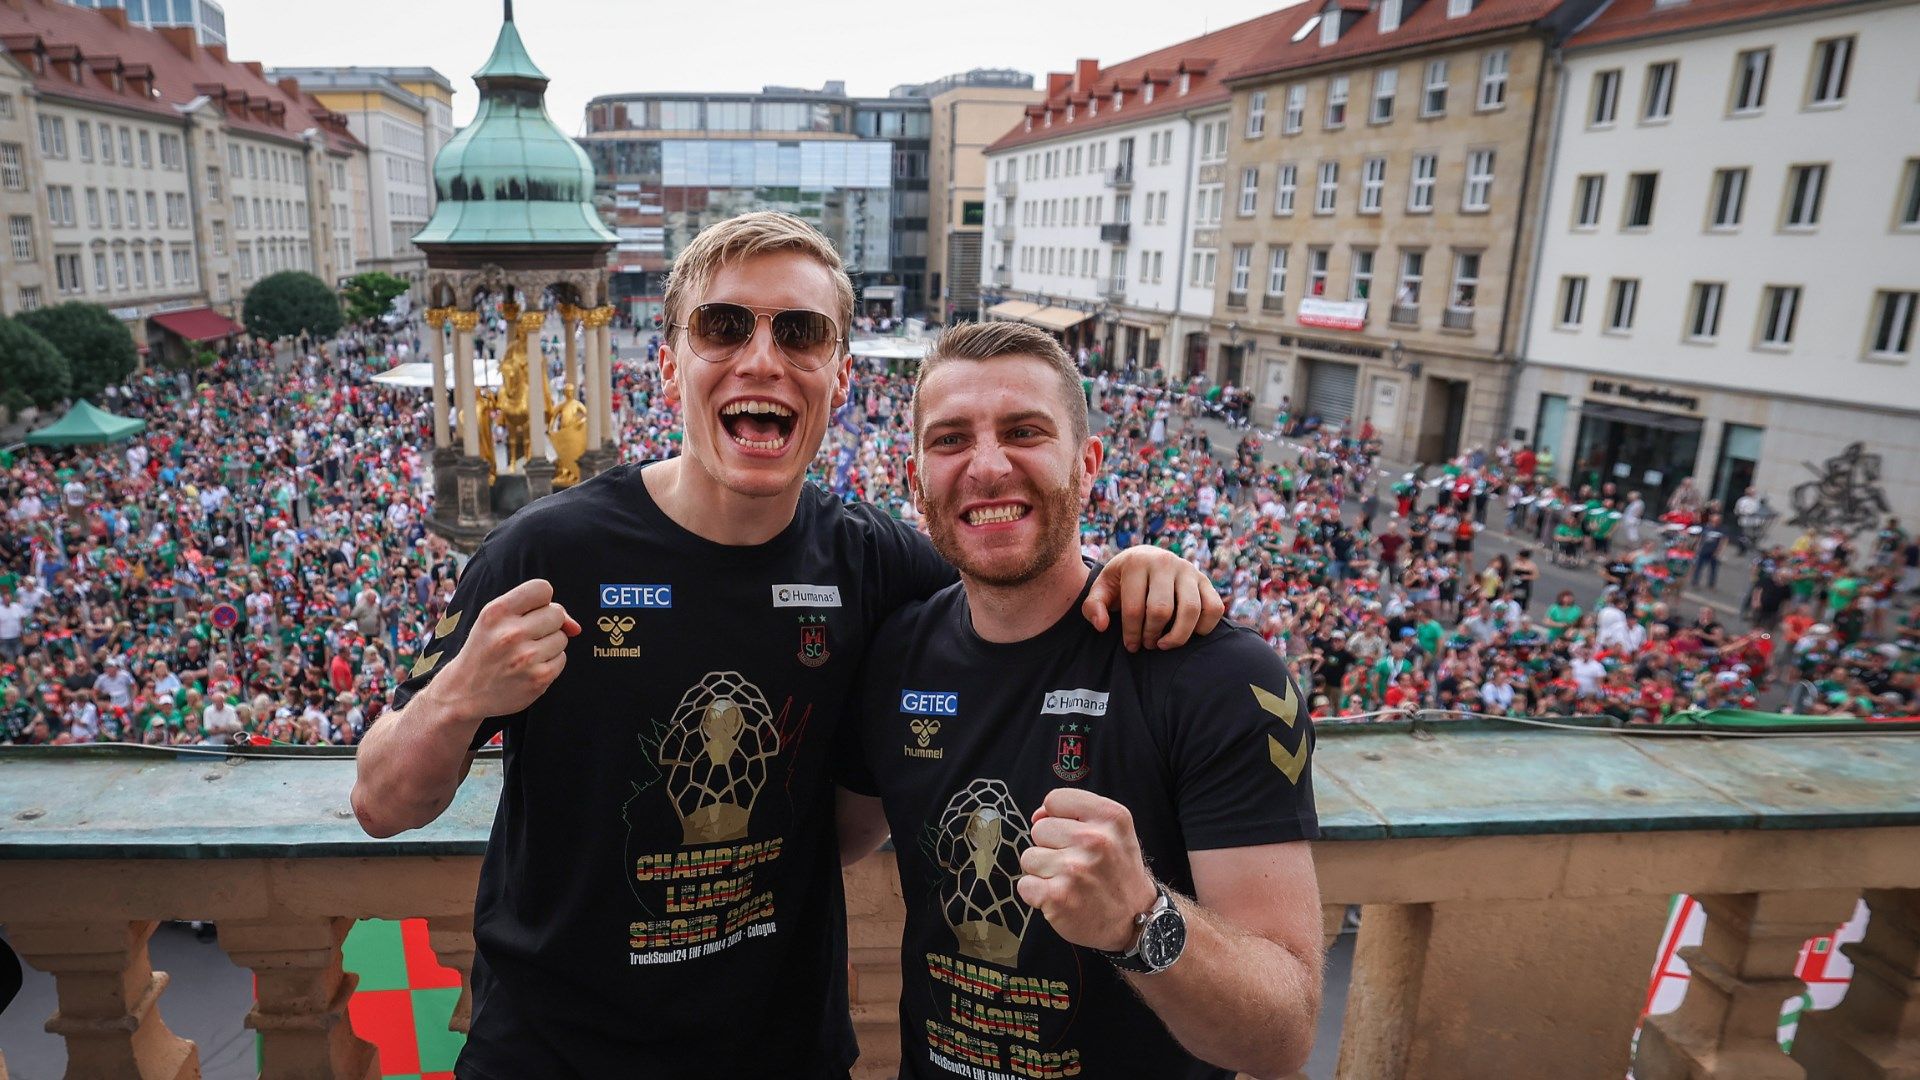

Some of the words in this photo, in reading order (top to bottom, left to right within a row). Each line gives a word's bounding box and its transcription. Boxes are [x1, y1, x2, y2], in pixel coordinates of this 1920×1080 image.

[602, 586, 670, 606] GETEC
[792, 590, 834, 602] Humanas
[593, 645, 641, 658] hummel
[805, 643, 822, 657] SC
[902, 693, 957, 713] GETEC
[904, 745, 943, 759] hummel
[1062, 755, 1080, 770] SC
[636, 837, 784, 881] CHAMPIONS
[666, 870, 754, 913] LEAGUE
[629, 914, 719, 949] SIEGER
[725, 890, 775, 935] 2023
[630, 947, 686, 965] TruckScout24
[688, 945, 702, 959] EHF
[703, 938, 726, 956] FINAL4
[727, 929, 742, 948] 2023
[747, 922, 777, 938] Cologne
[926, 952, 1070, 1011] CHAMPIONS
[951, 992, 1040, 1043] LEAGUE
[926, 1018, 1000, 1069] SIEGER
[1009, 1044, 1082, 1080] 2023
